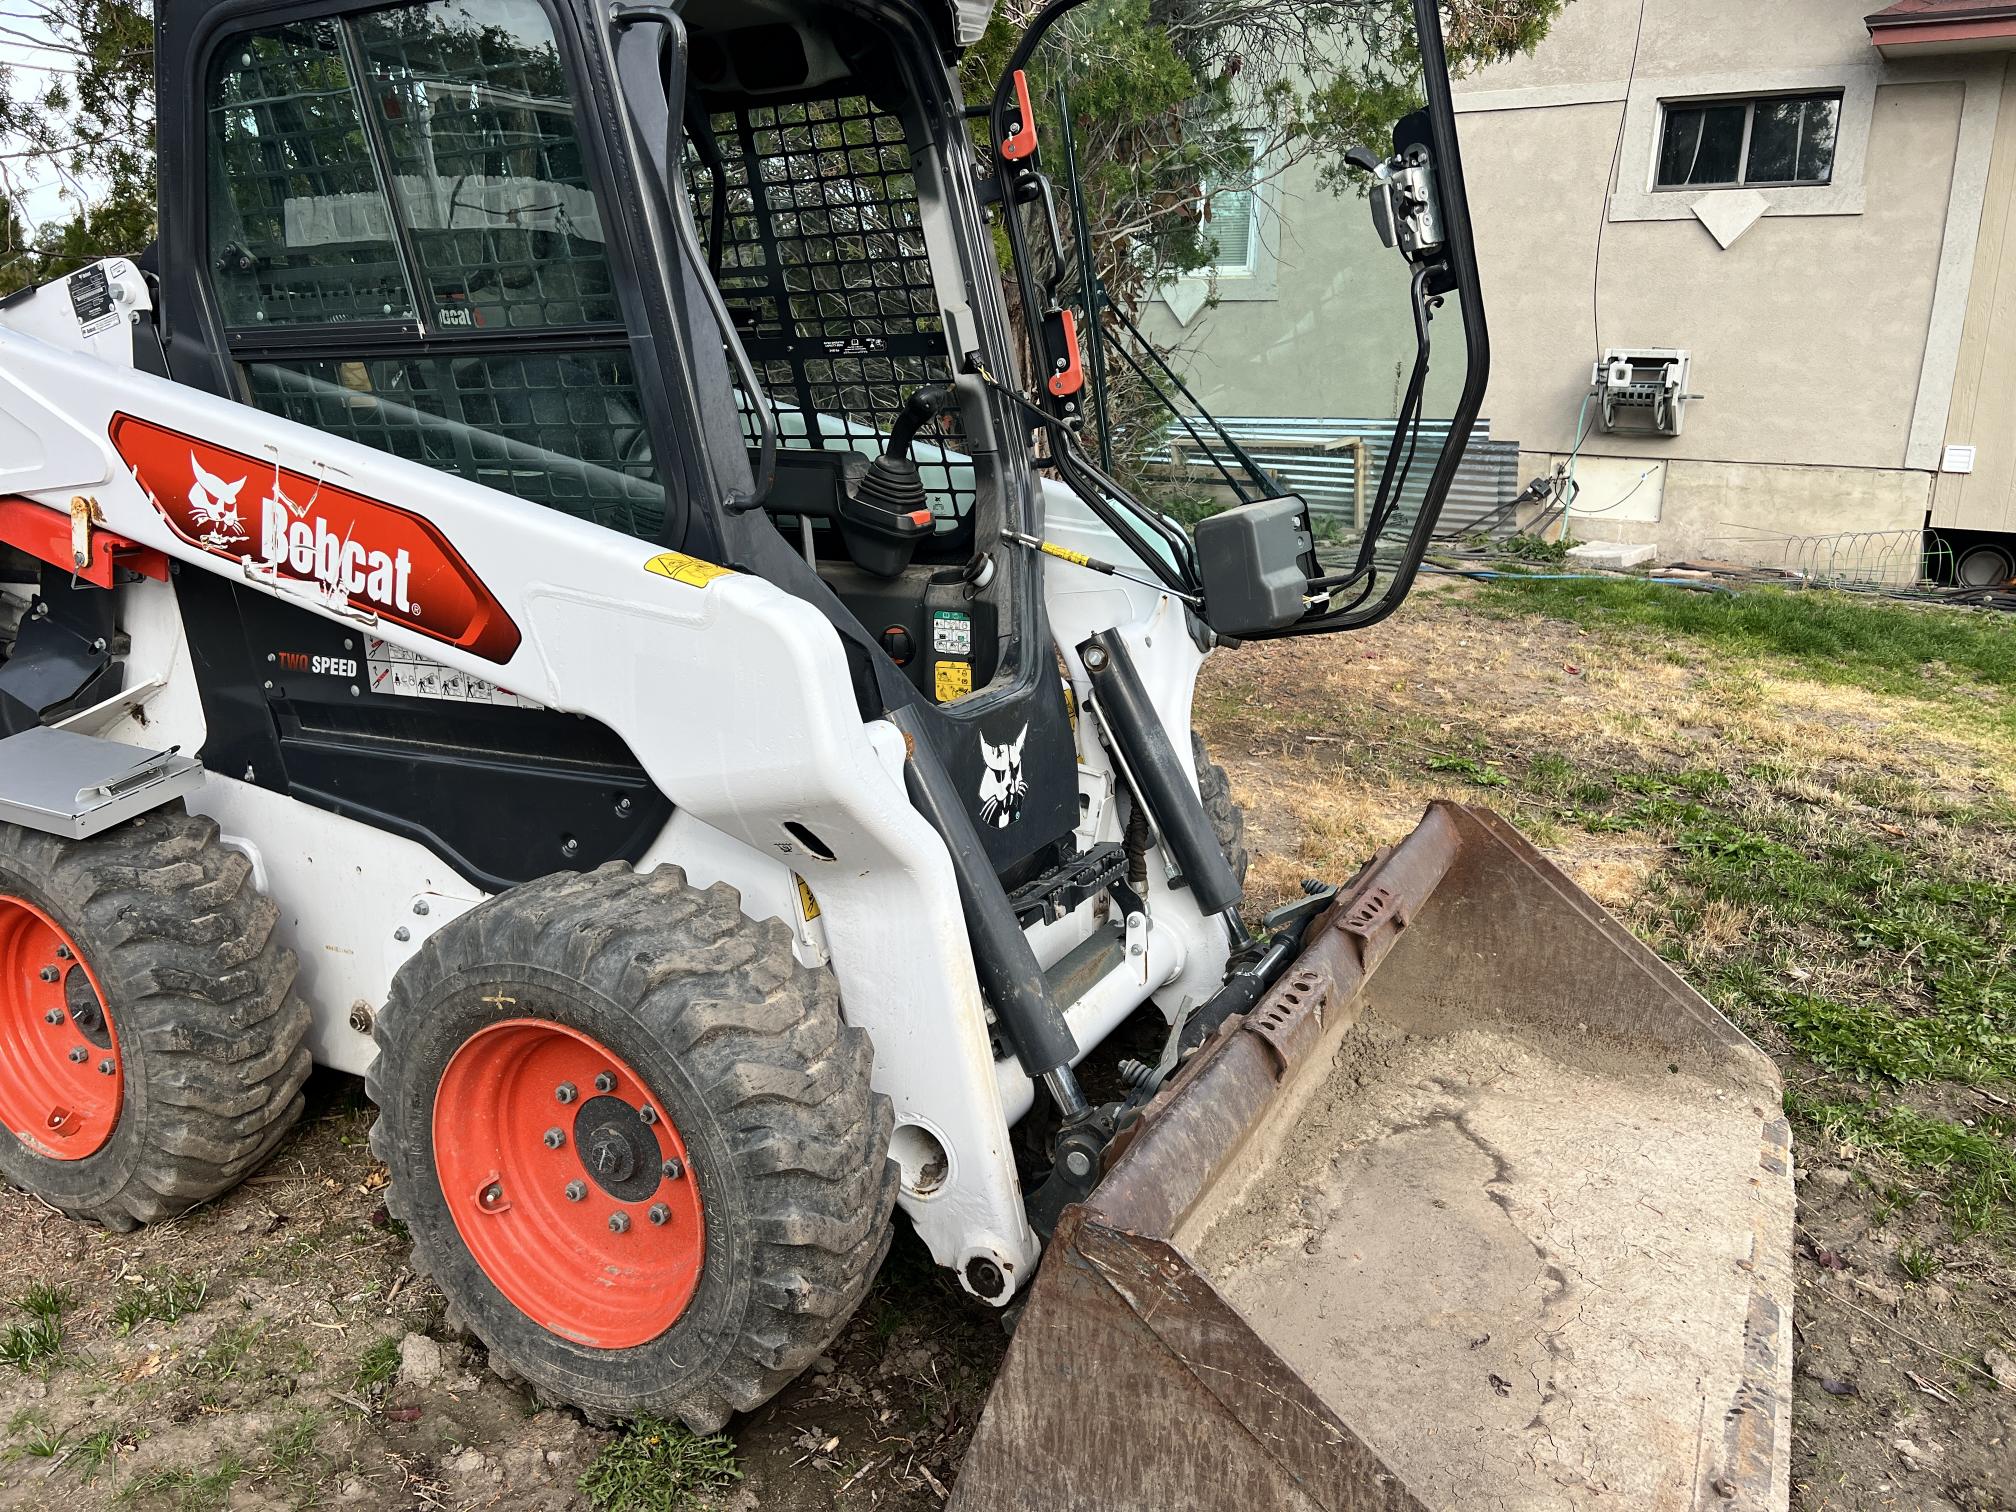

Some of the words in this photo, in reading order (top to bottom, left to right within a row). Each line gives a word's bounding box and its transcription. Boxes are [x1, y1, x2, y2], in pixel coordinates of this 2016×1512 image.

[261, 497, 412, 613] Bobcat
[278, 652, 309, 673] TWO
[311, 655, 358, 678] SPEED
